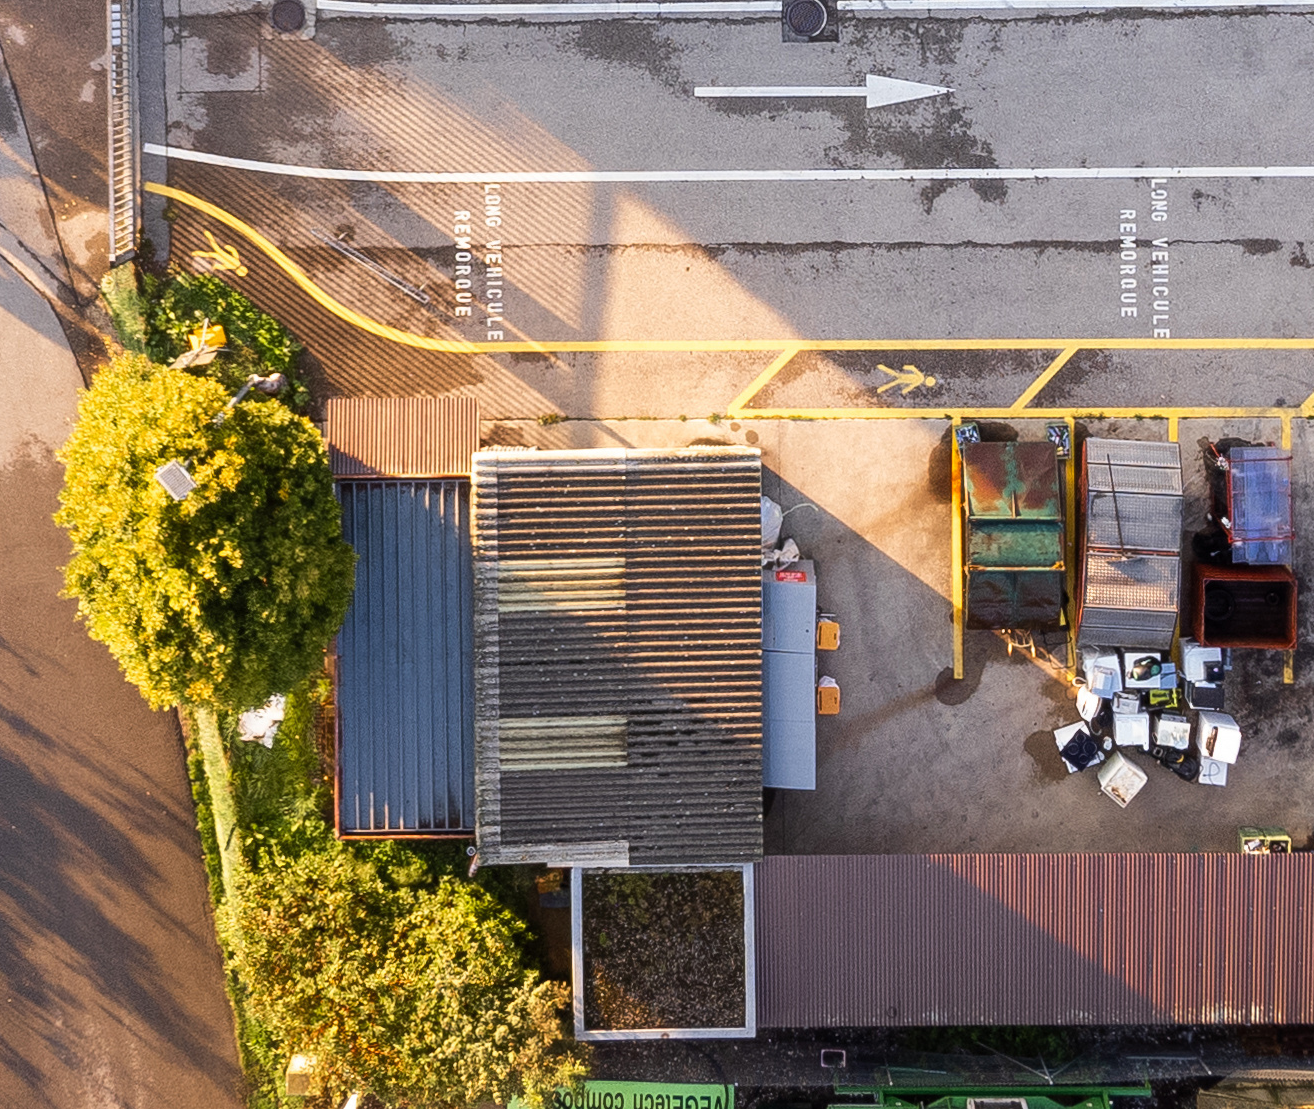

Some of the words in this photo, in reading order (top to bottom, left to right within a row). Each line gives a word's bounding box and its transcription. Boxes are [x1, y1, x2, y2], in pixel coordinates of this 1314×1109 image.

[484, 183, 502, 228] LONG
[1151, 178, 1168, 222] LONG
[454, 210, 472, 317] REMORQUE
[485, 240, 504, 341] VEHICULE
[1119, 209, 1137, 318] REMORQUE
[1152, 237, 1170, 339] VEHICULE
